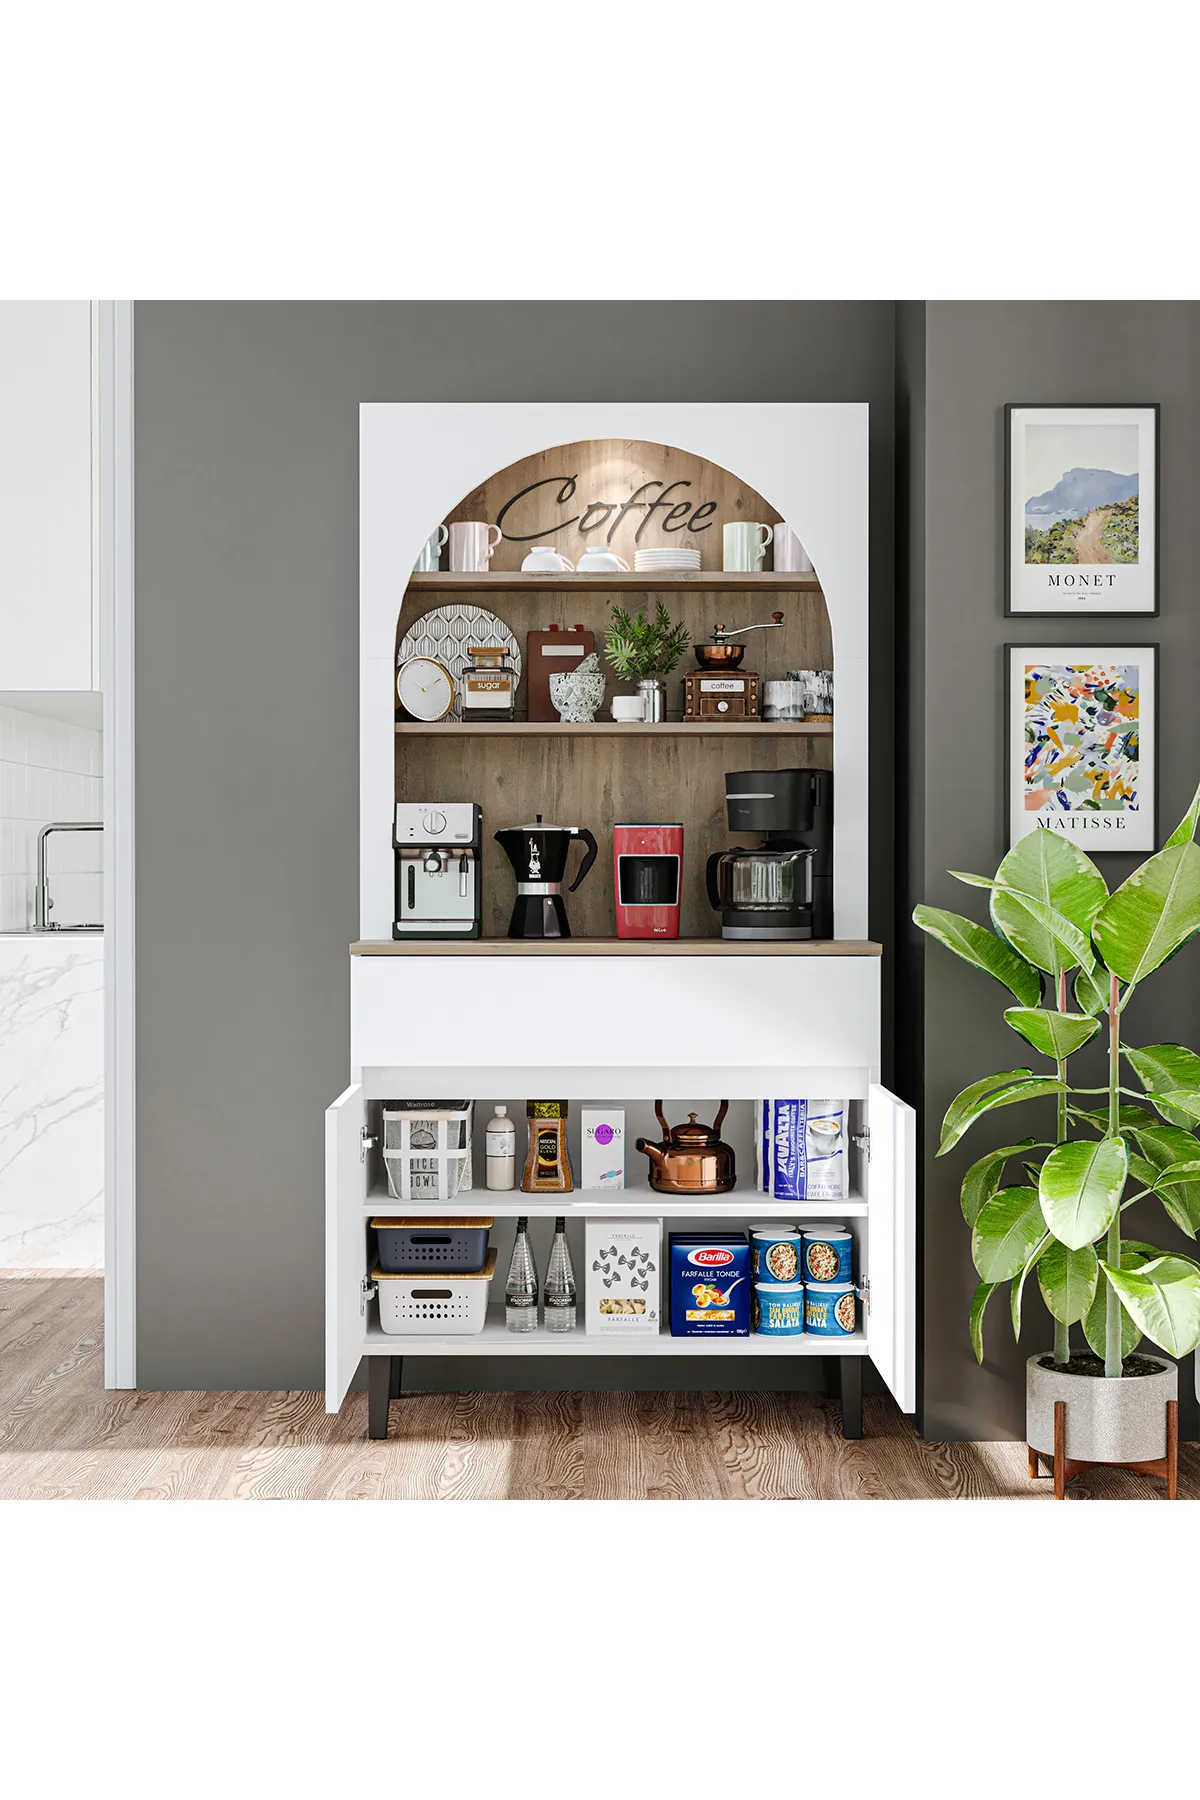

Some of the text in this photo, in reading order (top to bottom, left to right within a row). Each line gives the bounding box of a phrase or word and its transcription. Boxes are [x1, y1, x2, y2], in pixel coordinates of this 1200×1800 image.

[497, 474, 717, 543] Coffee
[1048, 574, 1116, 587] MONET
[477, 682, 501, 691] sugar
[710, 682, 735, 690] coffee
[1037, 817, 1126, 829] MATISSE
[586, 1127, 622, 1135] SUGARO
[775, 1104, 790, 1176] LAVAZZA
[409, 1158, 434, 1170] RICE
[698, 1252, 730, 1262] Barilla
[681, 1270, 740, 1278] FARFALLE TONDE
[769, 1312, 800, 1320] FARFALLE
[769, 1318, 800, 1328] SALATA
